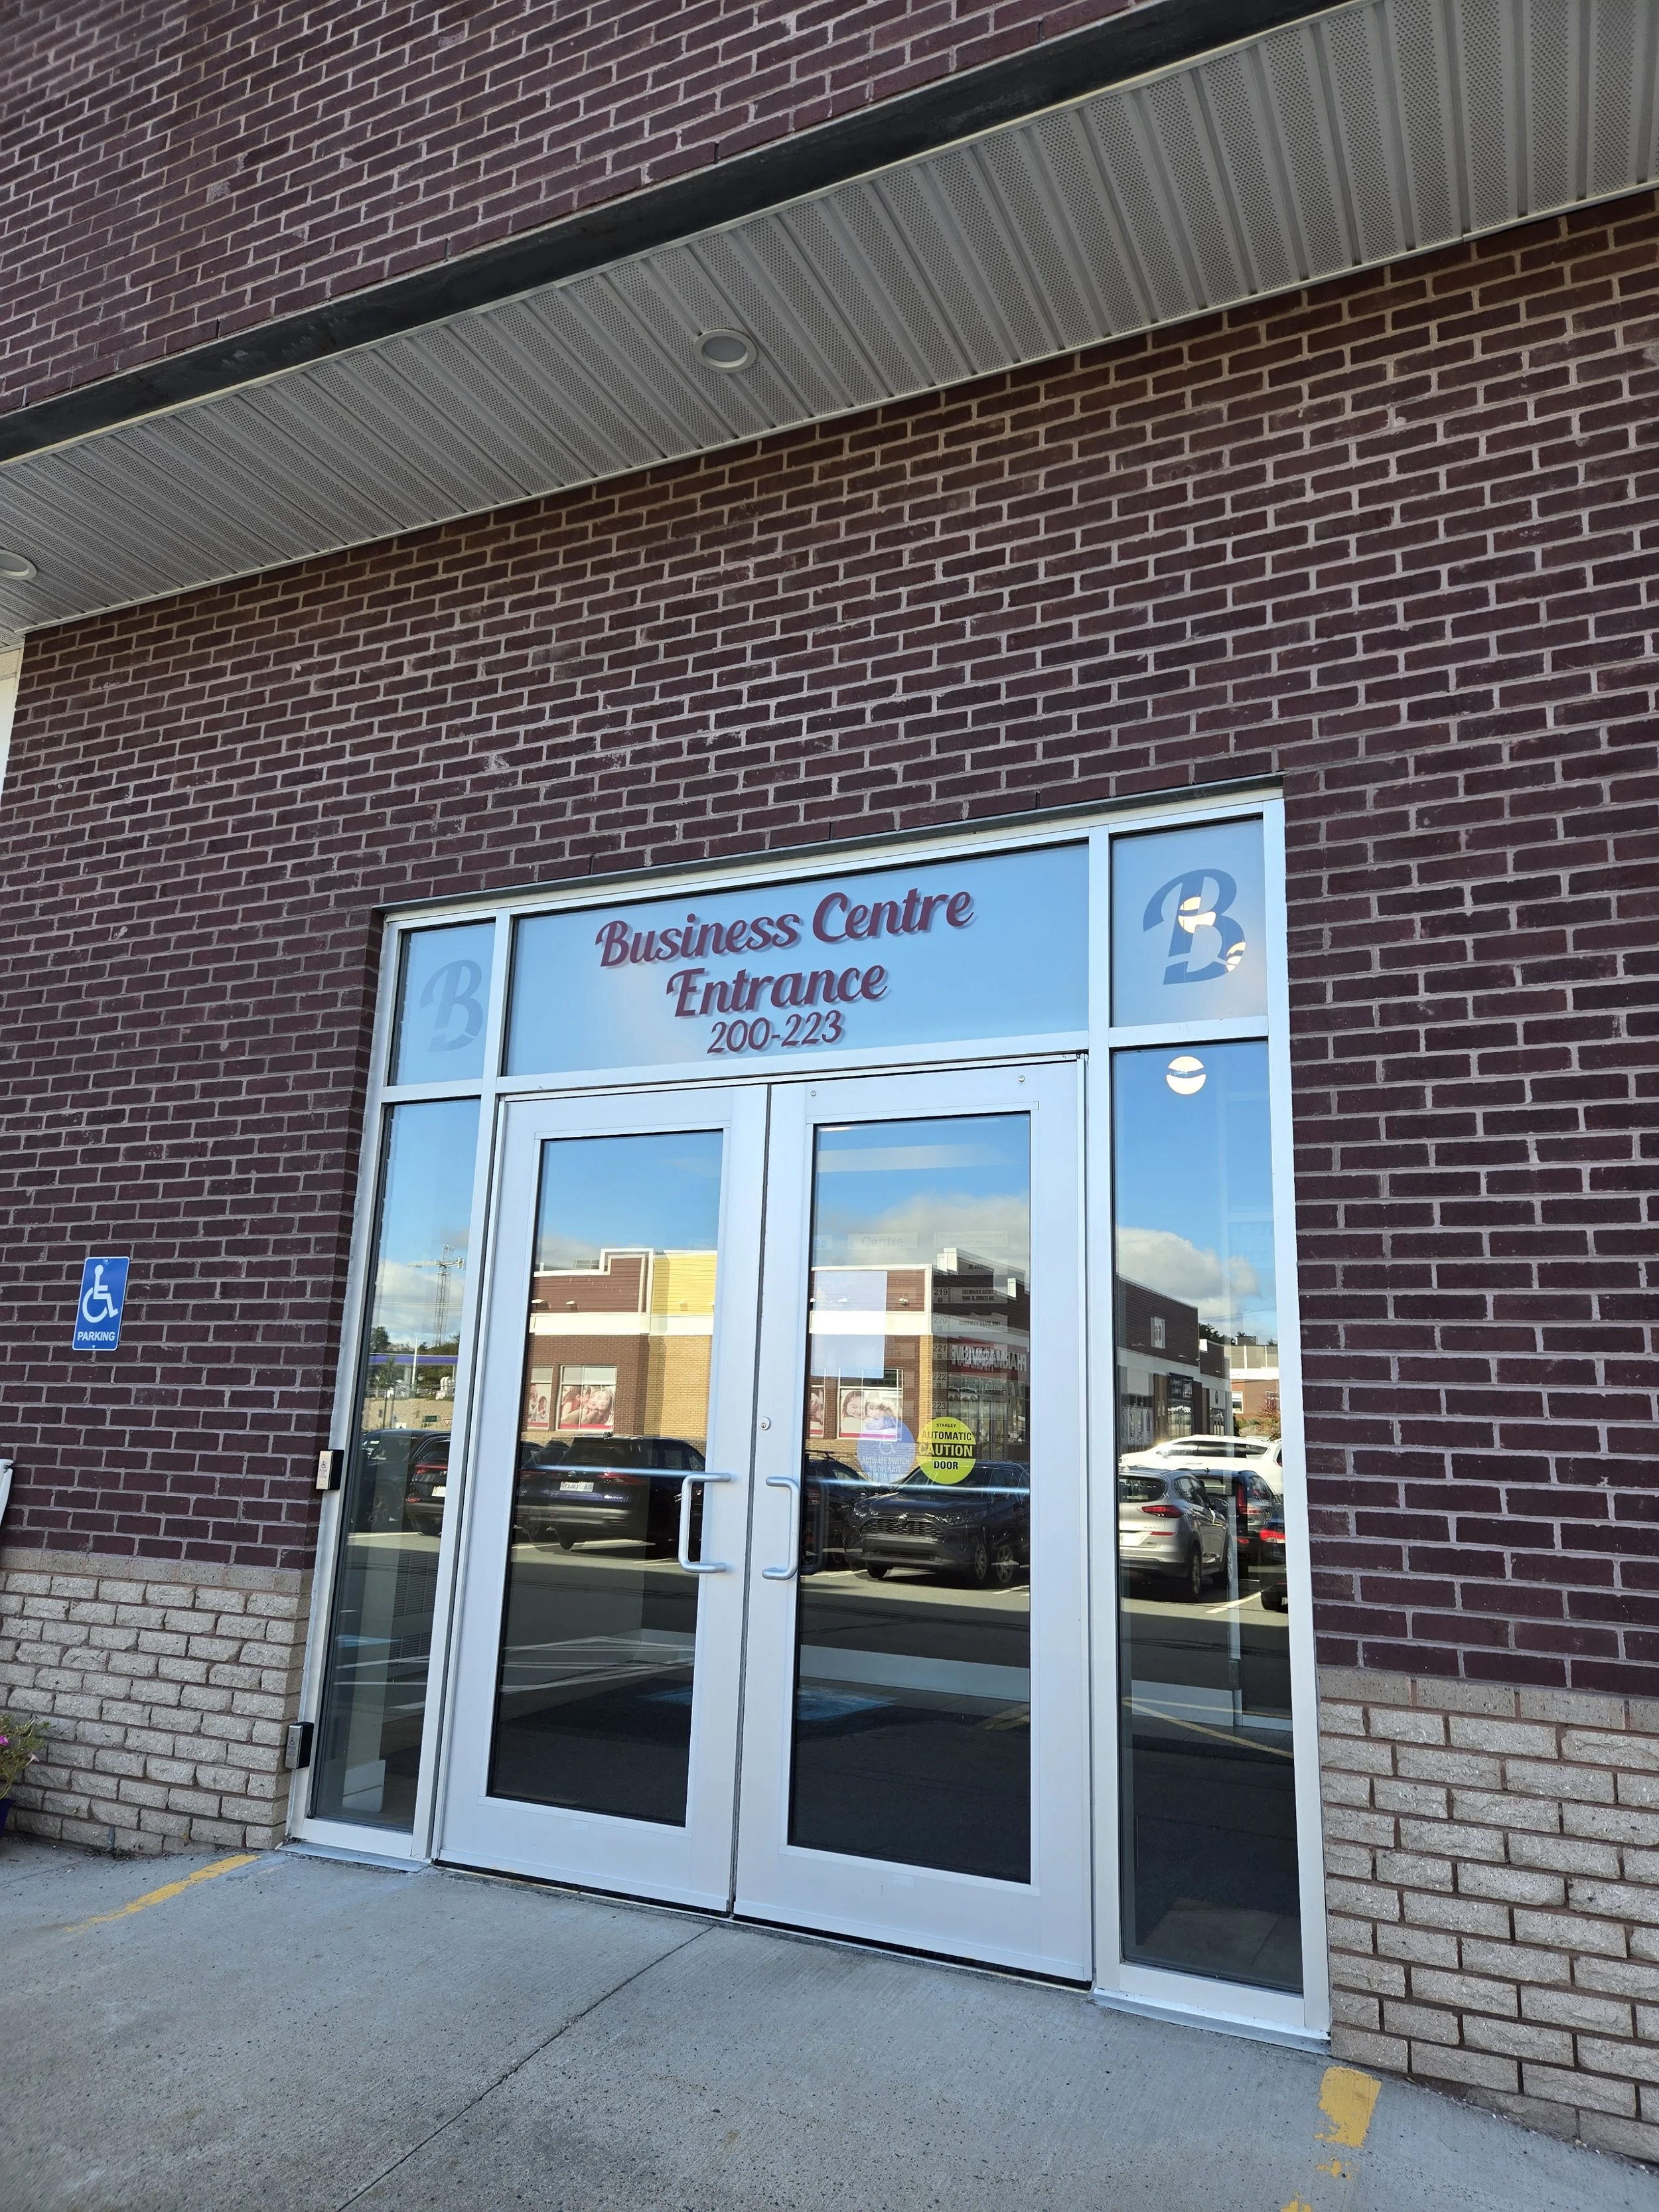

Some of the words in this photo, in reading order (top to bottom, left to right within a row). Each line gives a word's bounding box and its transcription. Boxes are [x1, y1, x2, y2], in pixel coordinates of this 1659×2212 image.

[595, 913, 800, 968] Business
[812, 887, 975, 942] Centre
[666, 964, 888, 1017] Entrance
[705, 1009, 843, 1055] 200-223
[863, 1236, 904, 1248] Centre
[77, 1331, 115, 1341] PARKING
[932, 1372, 947, 1381] 222
[921, 1430, 972, 1441] AUTOMATIC
[918, 1443, 974, 1457] CAUTION
[934, 1461, 959, 1470] DOOR
